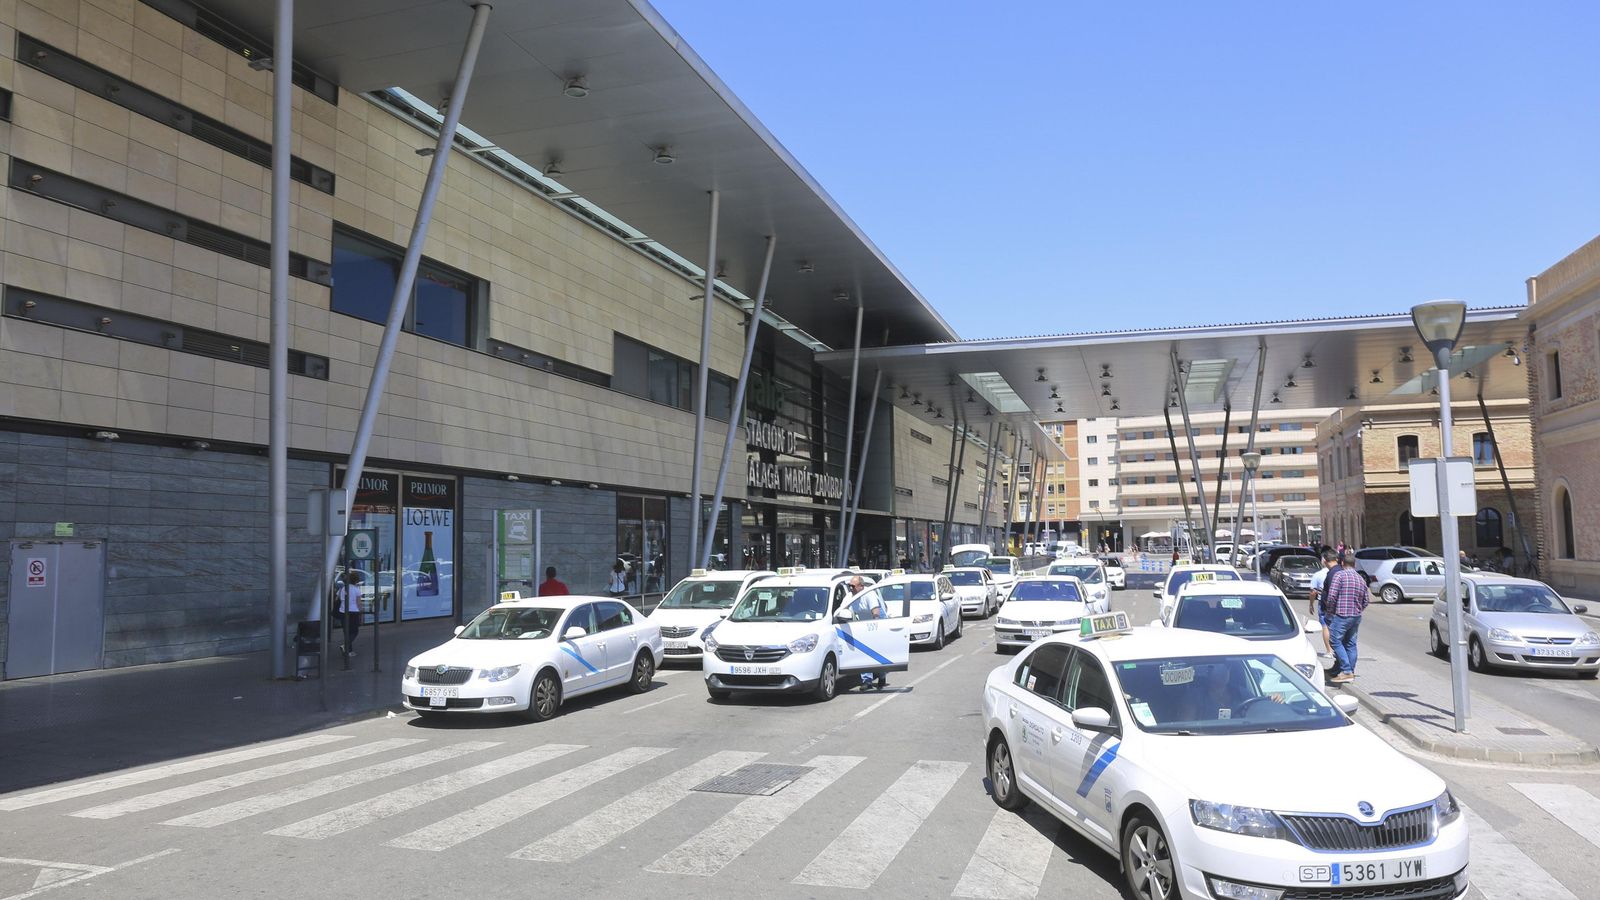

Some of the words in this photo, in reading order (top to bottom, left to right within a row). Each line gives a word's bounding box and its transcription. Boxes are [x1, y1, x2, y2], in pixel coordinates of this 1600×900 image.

[746, 418, 785, 453] STACIÓN
[357, 477, 388, 491] IMOR
[747, 455, 781, 490] ÁLAGA
[784, 465, 813, 495] MARÍA
[814, 473, 853, 501] ZAMBRAO
[410, 481, 447, 496] PRIMOR
[406, 508, 450, 527] LOEWE
[503, 512, 530, 520] TAXI
[1093, 615, 1117, 632] TAXI
[1164, 668, 1193, 683] OCUPADO
[424, 687, 441, 697] 6857
[442, 688, 457, 697] GYS
[1303, 867, 1327, 880] SP
[1343, 863, 1385, 882] 5361
[1393, 859, 1422, 879] JYW
